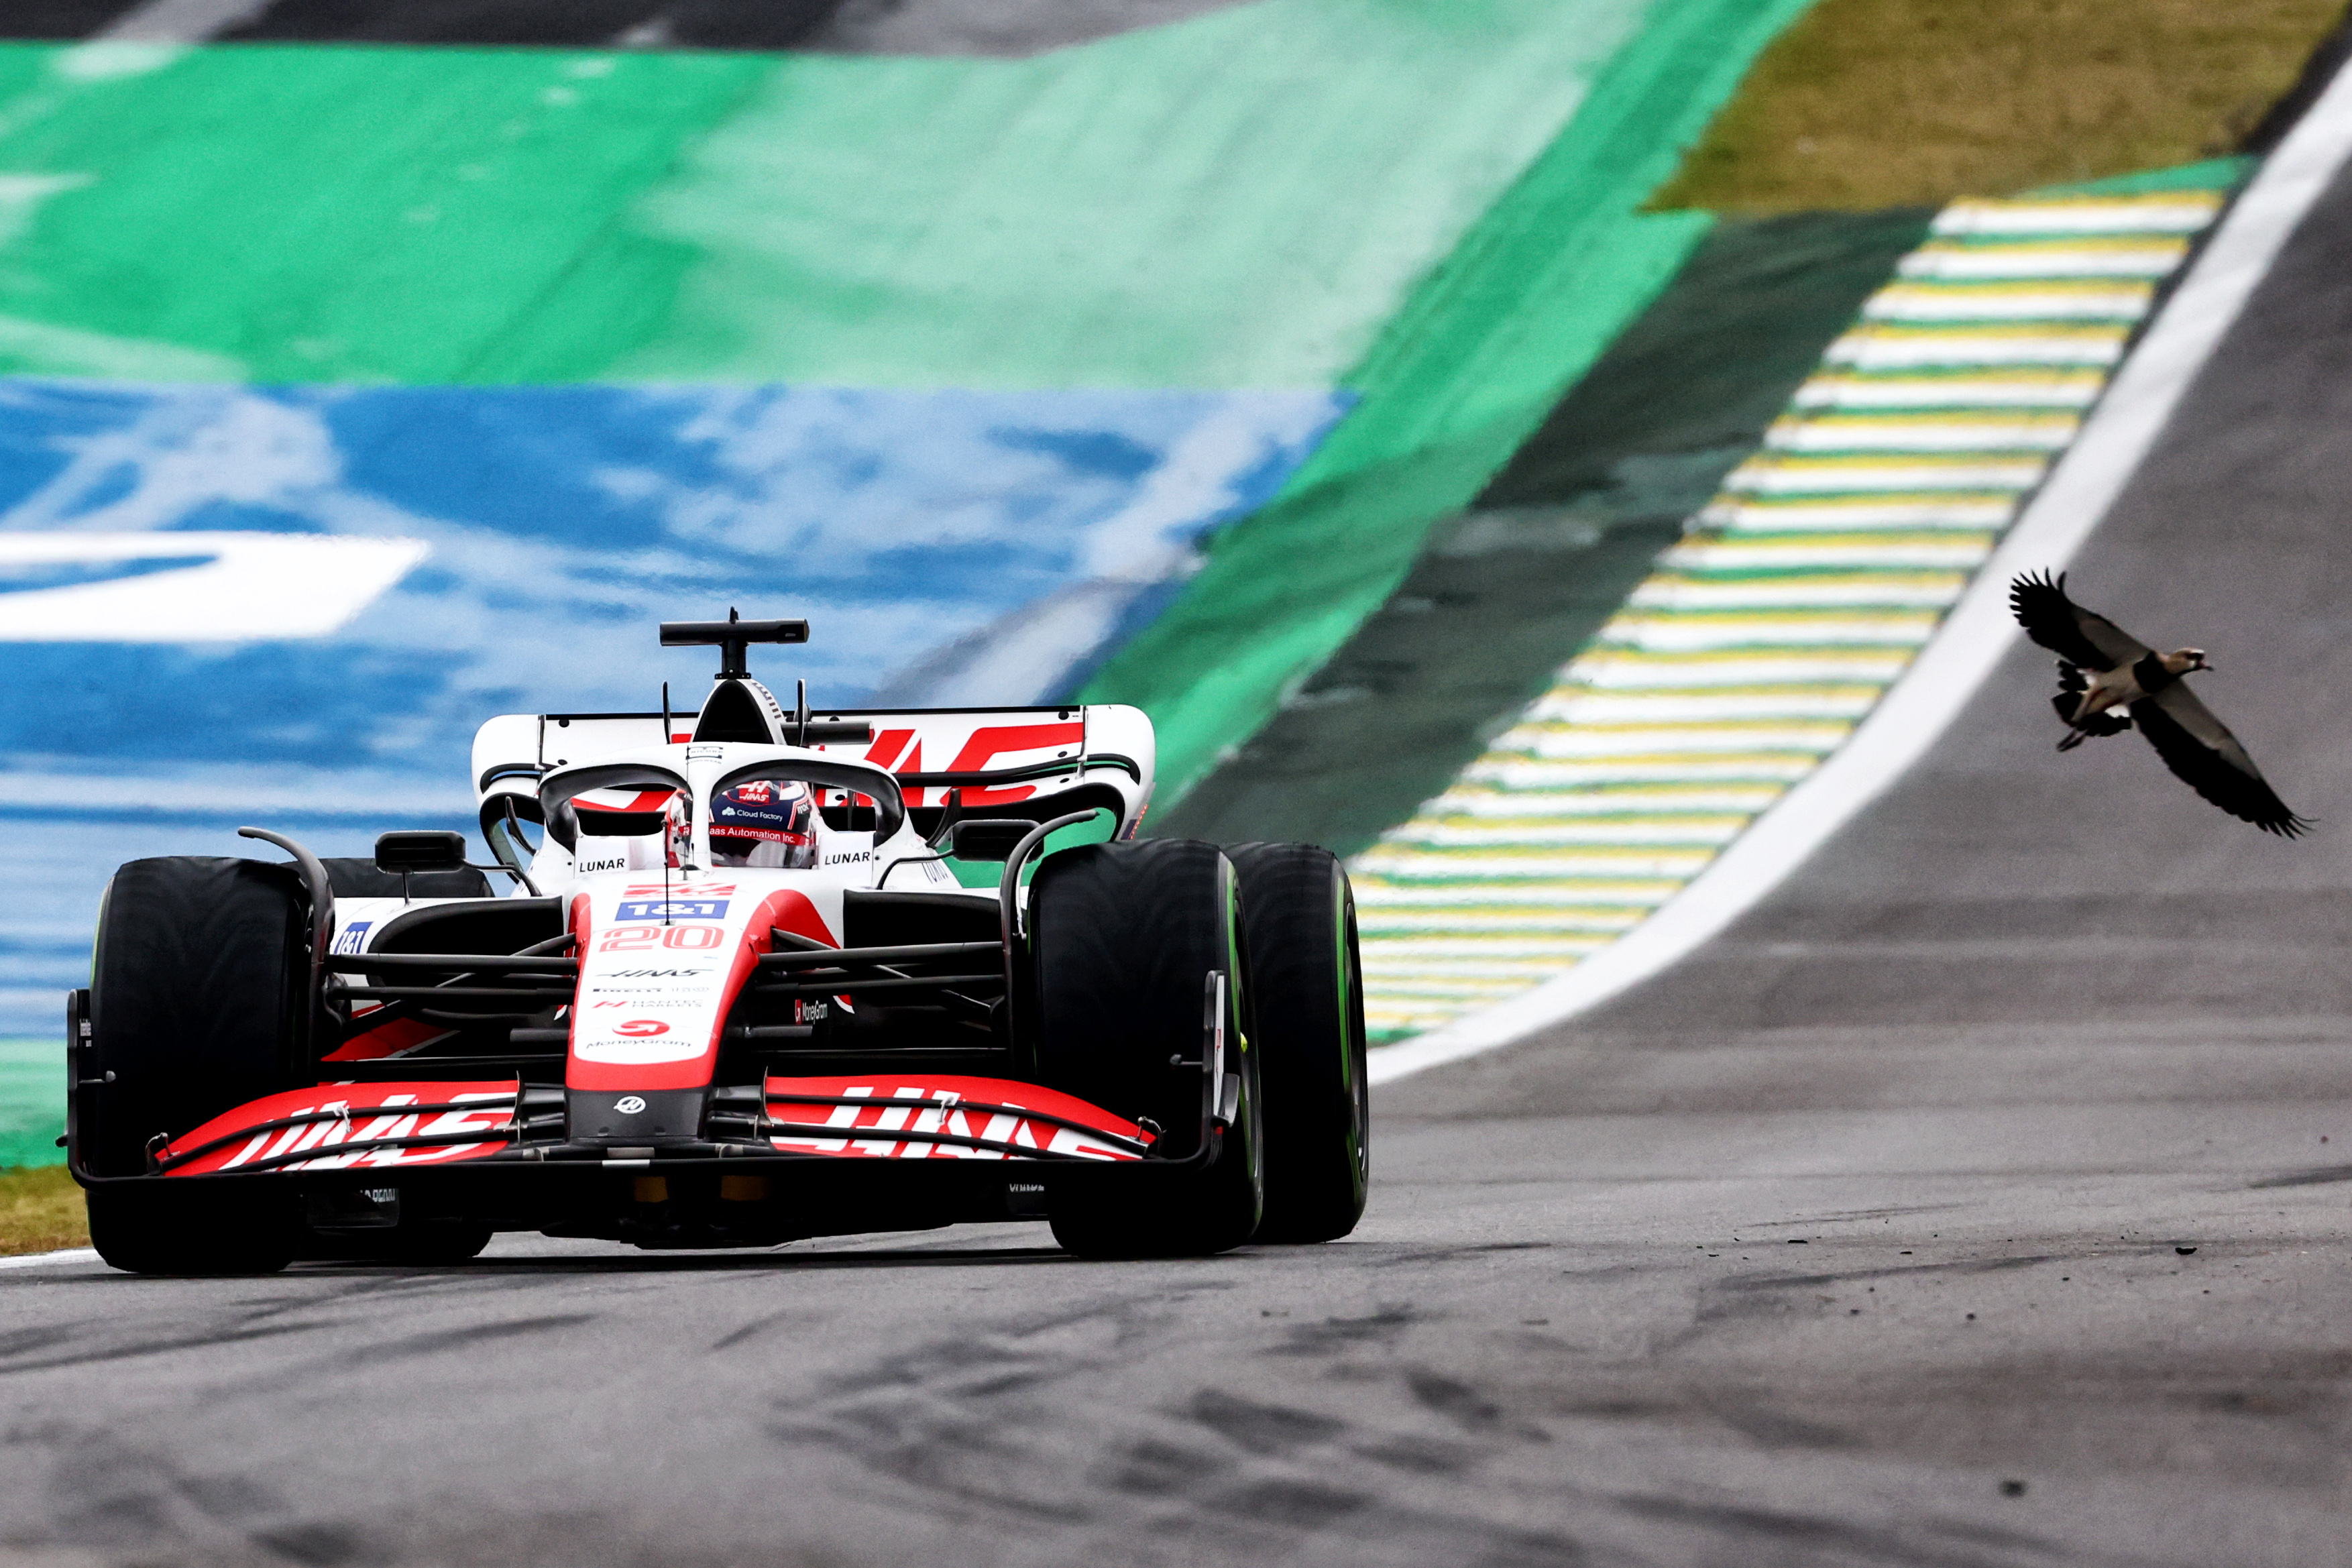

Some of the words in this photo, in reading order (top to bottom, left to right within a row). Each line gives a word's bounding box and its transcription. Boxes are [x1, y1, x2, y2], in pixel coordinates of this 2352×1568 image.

[739, 793, 769, 801] HAAS
[736, 809, 759, 818] Cloud
[759, 811, 783, 822] Factory
[709, 828, 726, 836] aas
[727, 827, 781, 840] Automation
[783, 833, 795, 843] Inc.
[579, 858, 625, 873] LUNAR
[824, 852, 871, 865] LUNAR
[628, 903, 716, 916] 1&1
[339, 931, 364, 954] 1&1
[599, 925, 724, 952] 20
[802, 999, 828, 1025] MoneyGram
[586, 1038, 691, 1049] MoneyGram
